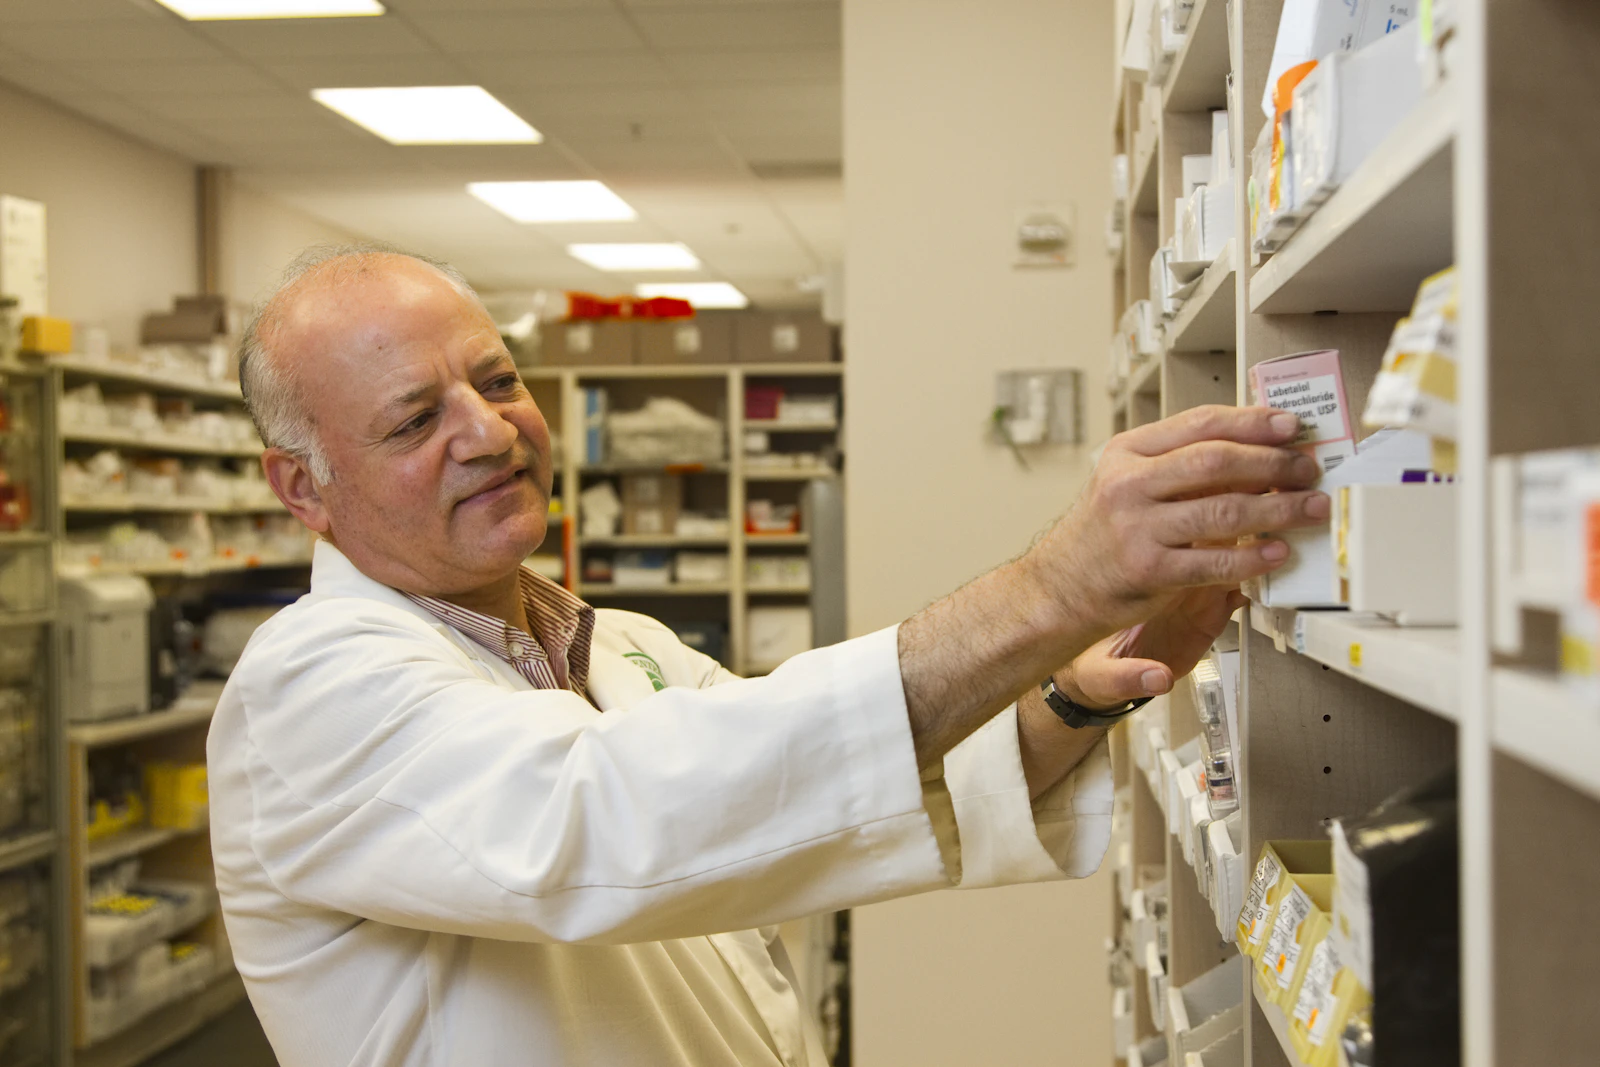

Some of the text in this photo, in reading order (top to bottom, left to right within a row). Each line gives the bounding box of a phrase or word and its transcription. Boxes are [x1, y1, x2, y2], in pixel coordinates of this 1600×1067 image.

[1267, 381, 1310, 398] Labetalol
[1270, 391, 1335, 409] Hydrochloride
[1317, 403, 1337, 415] USP
